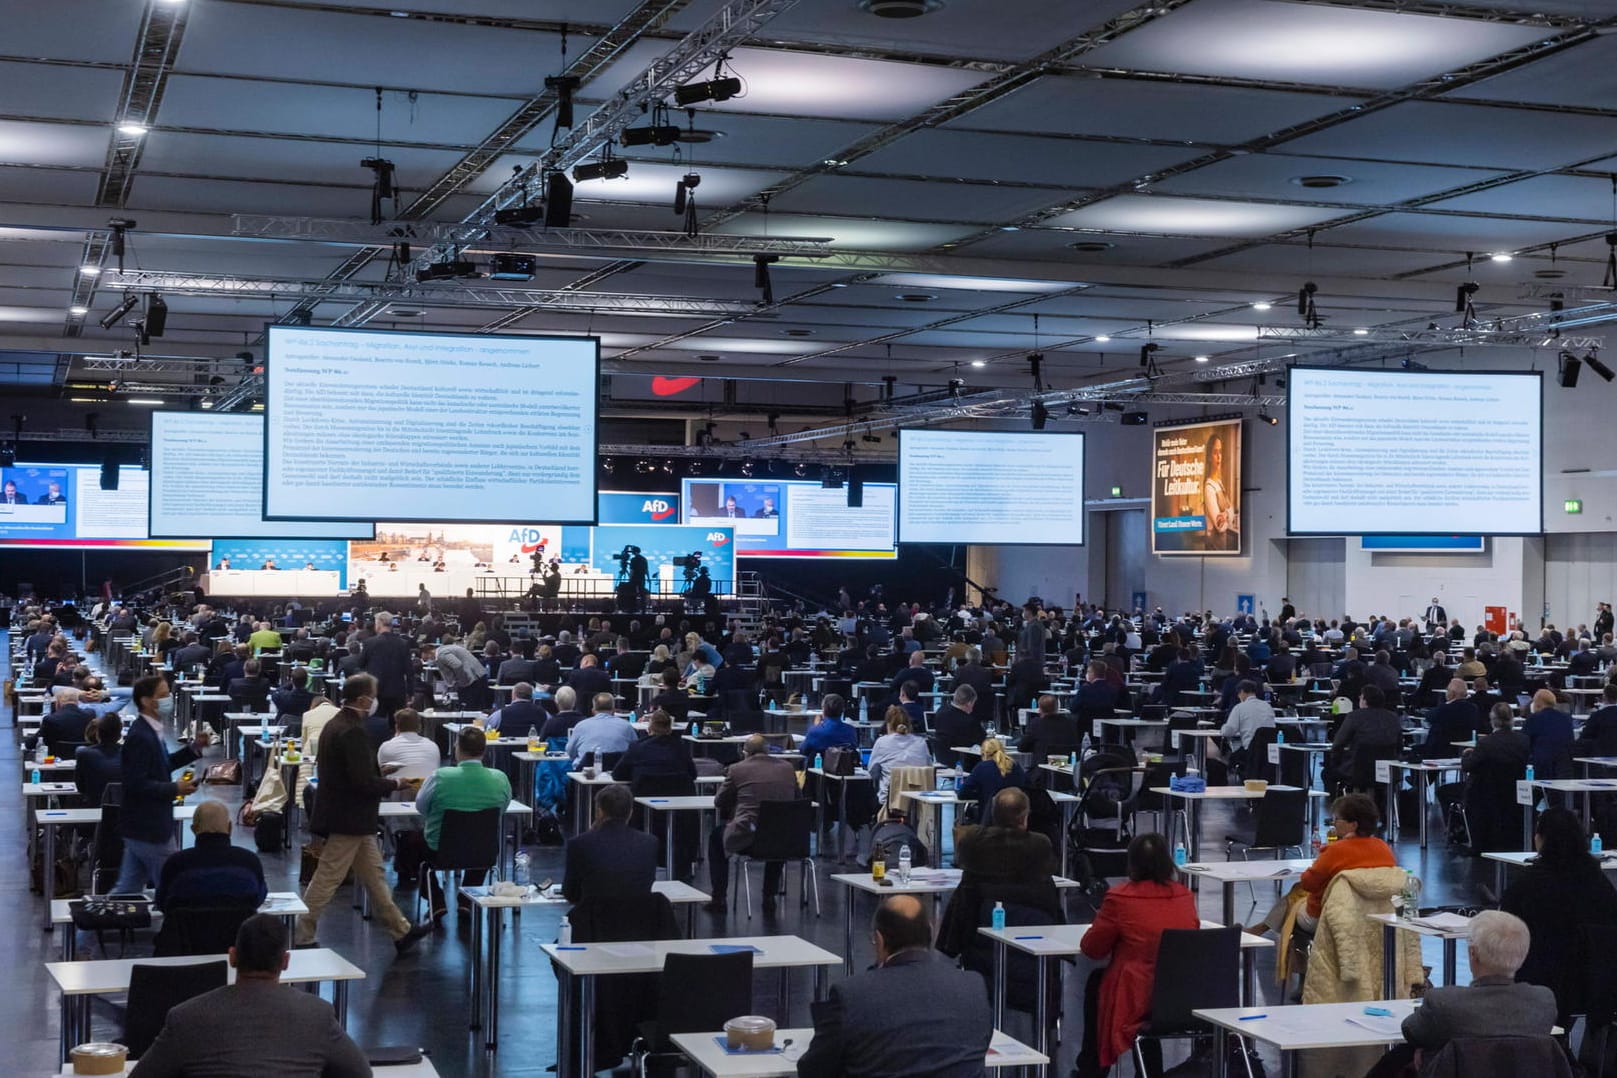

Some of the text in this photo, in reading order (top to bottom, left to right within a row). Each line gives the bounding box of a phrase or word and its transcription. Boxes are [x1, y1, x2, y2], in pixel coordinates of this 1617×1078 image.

[642, 500, 668, 512] AfD
[508, 528, 540, 543] AfD
[706, 532, 725, 541] AfD
